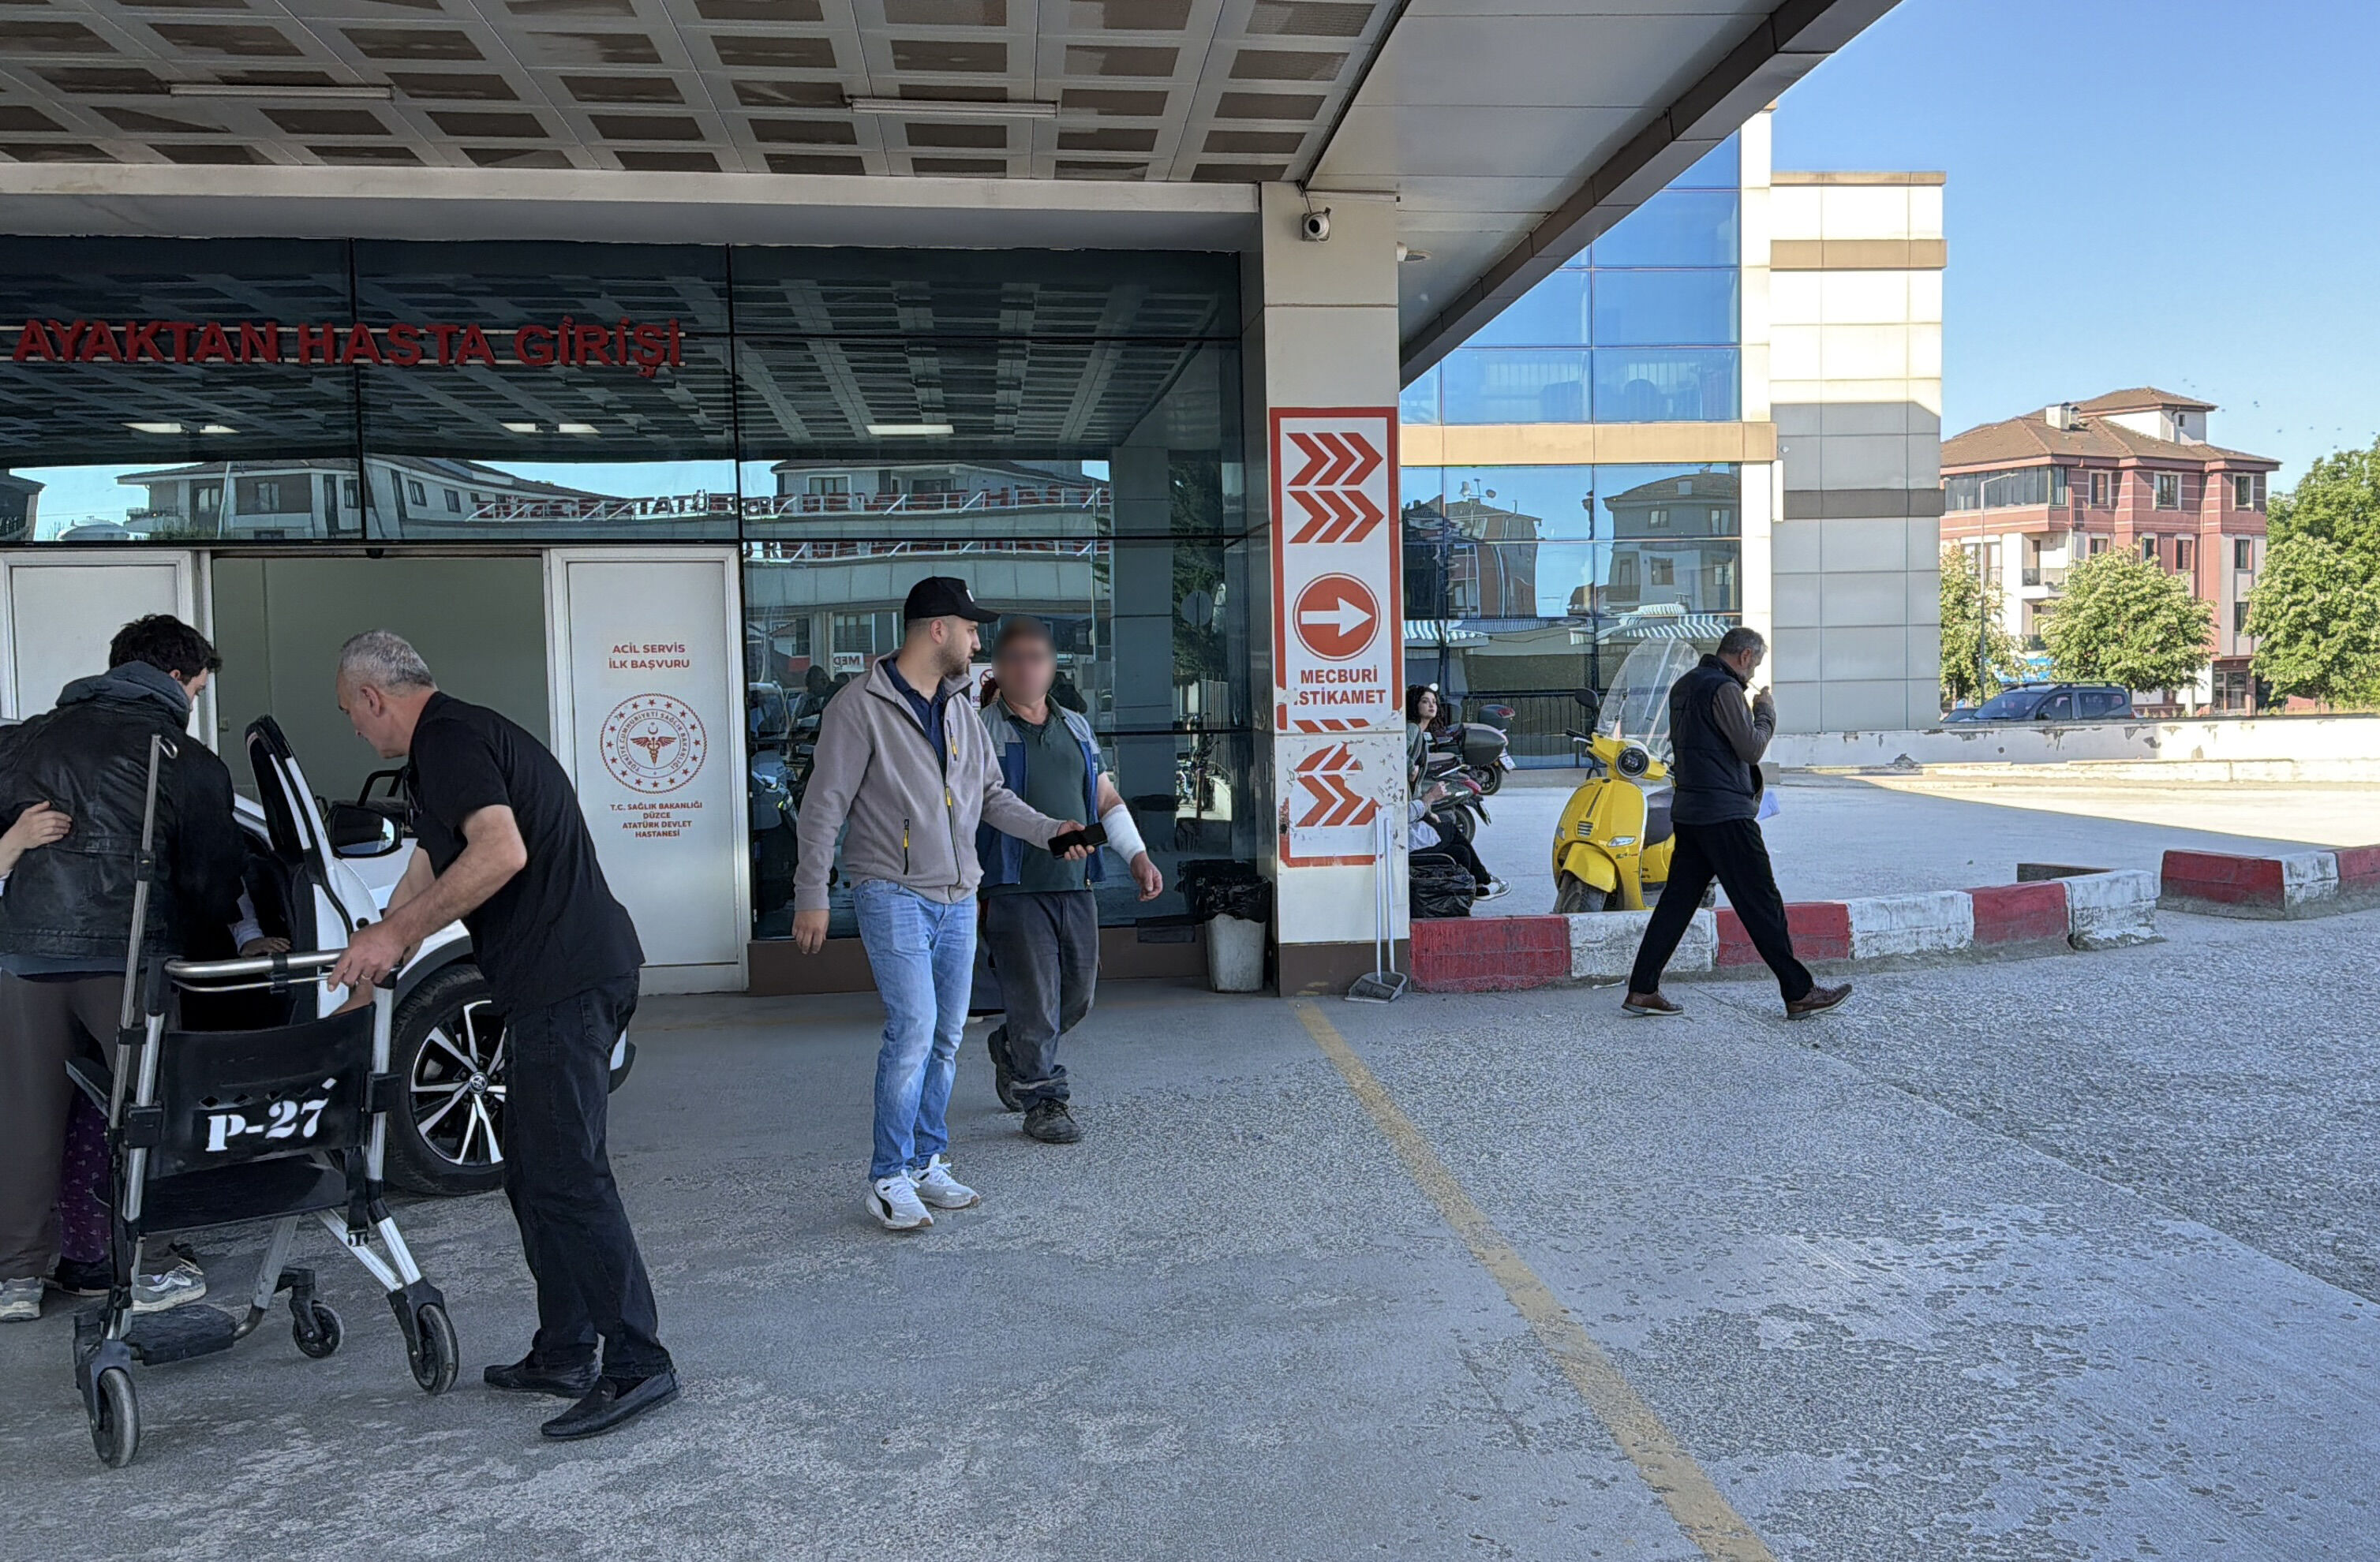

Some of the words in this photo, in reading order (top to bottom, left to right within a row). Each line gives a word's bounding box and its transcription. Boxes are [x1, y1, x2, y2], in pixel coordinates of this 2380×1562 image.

[13, 319, 279, 364] AYAKTAN
[298, 322, 496, 366] HASTA
[514, 316, 681, 379] GİRİŞİ
[612, 641, 640, 653] ACİL
[642, 641, 685, 653] SERVİS
[608, 657, 628, 668] İLK
[631, 659, 690, 671] BAŞVURU
[1300, 664, 1377, 684] MECBURİ
[658, 801, 702, 809] BAKANLIĞI
[635, 829, 680, 838] HASTANESİ
[205, 1097, 329, 1153] P-27
